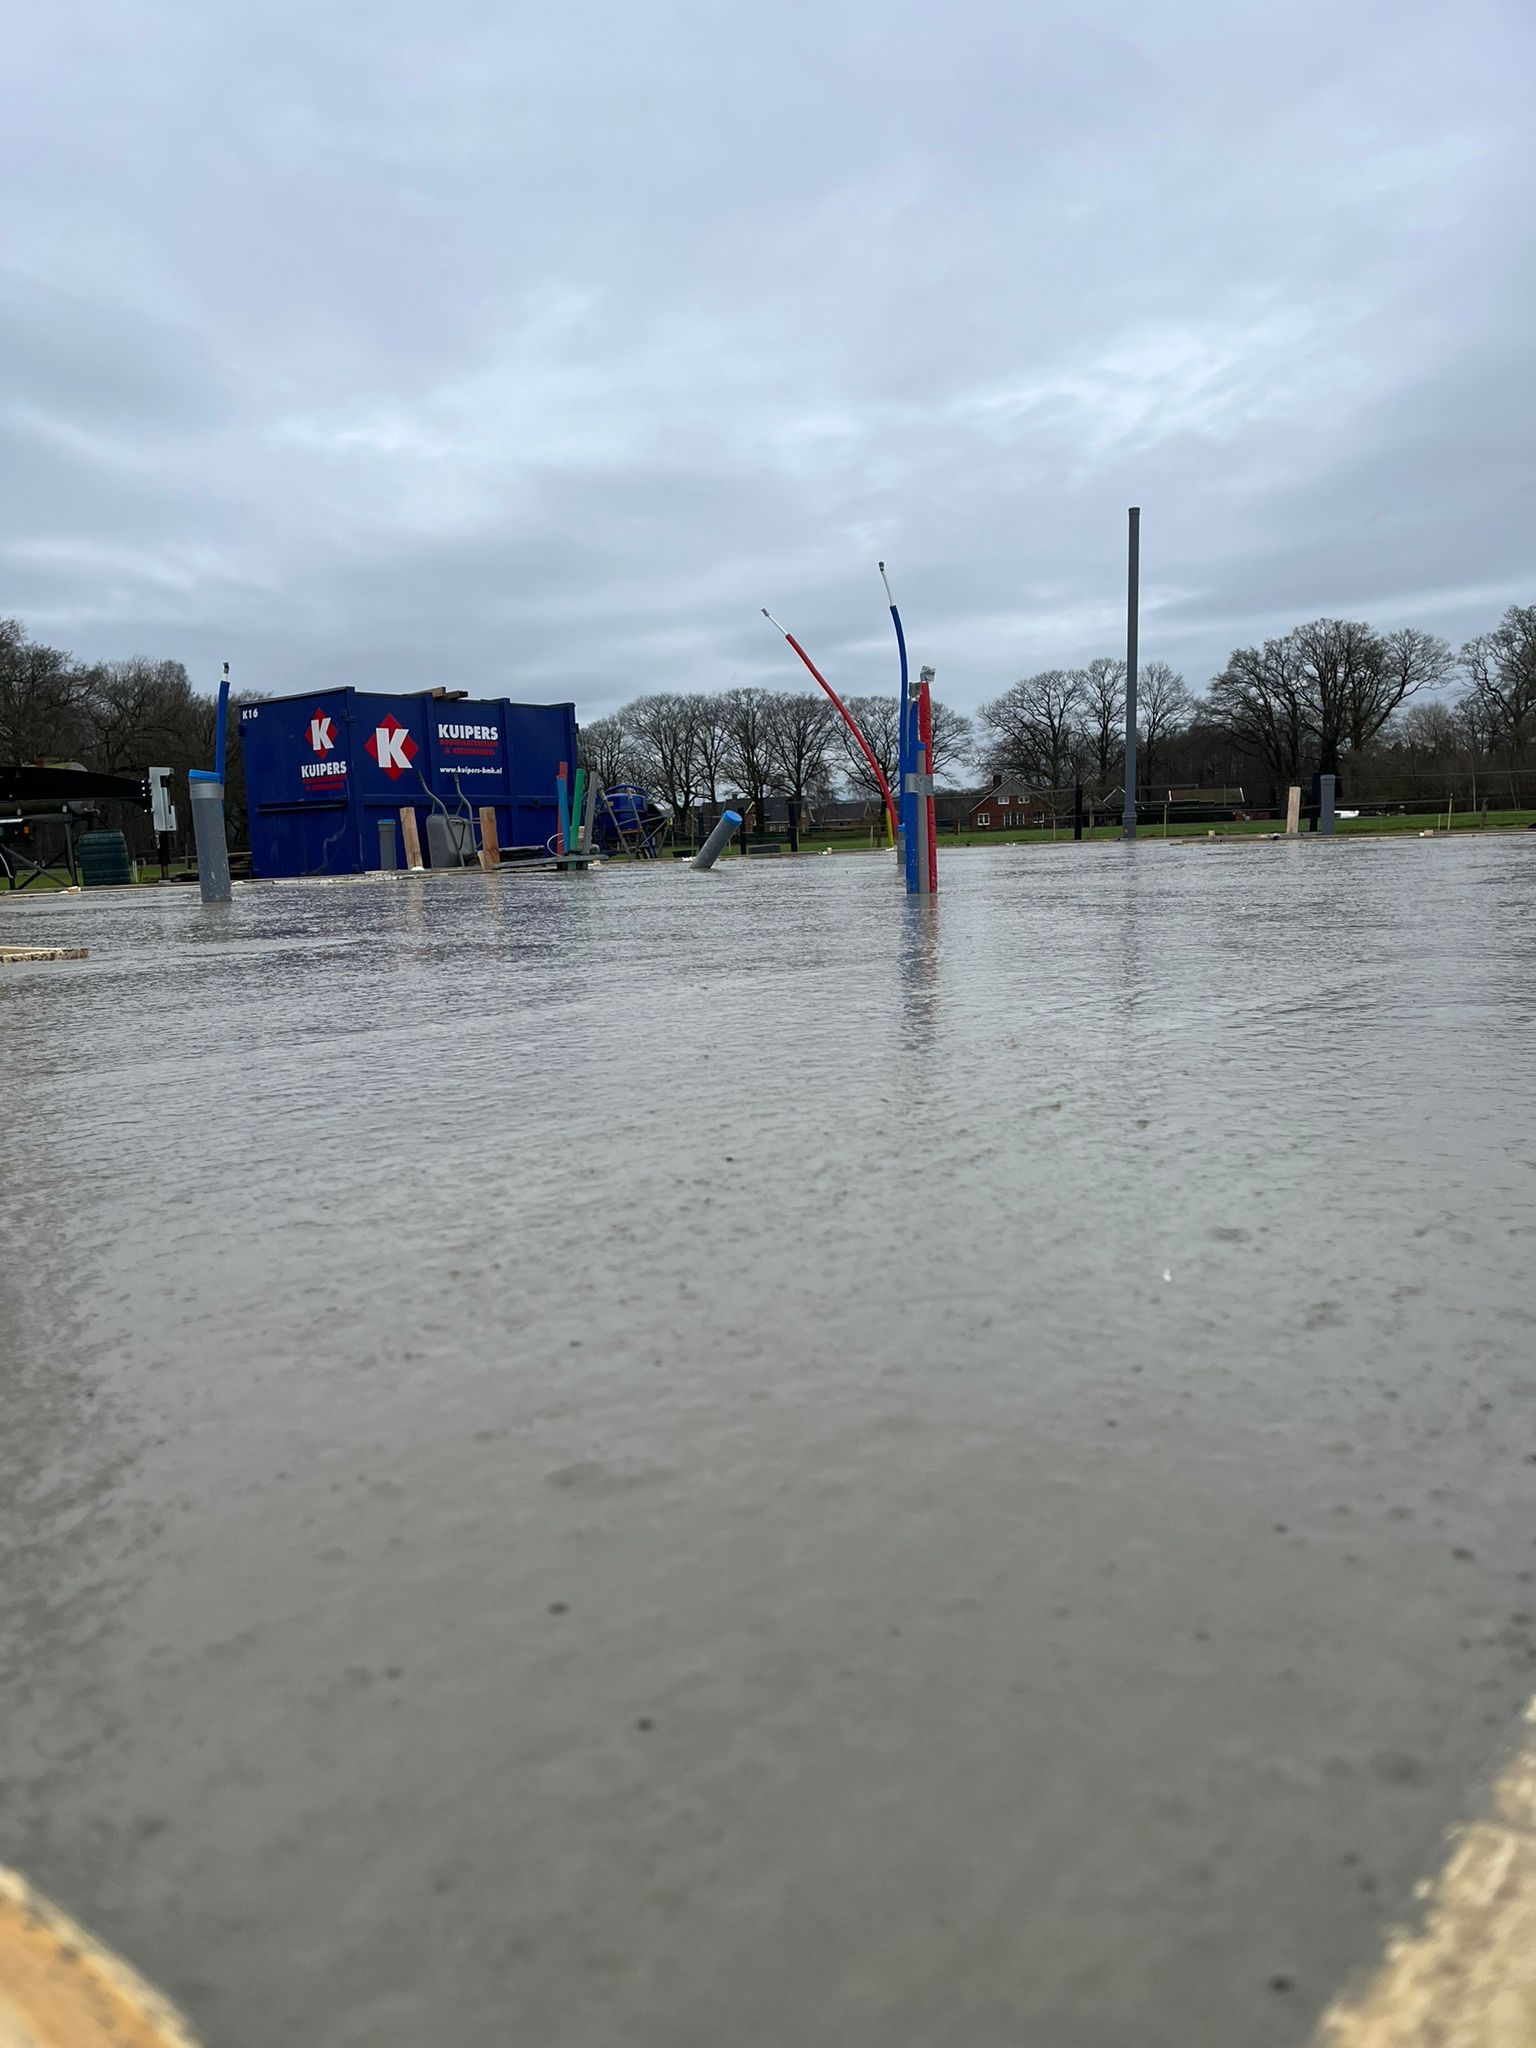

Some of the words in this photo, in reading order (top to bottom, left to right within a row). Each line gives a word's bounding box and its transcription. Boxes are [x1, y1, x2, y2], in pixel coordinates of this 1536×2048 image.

[242, 708, 258, 720] K16
[311, 717, 334, 751] K
[438, 724, 498, 740] KUIPERS
[376, 727, 413, 769] K
[301, 760, 347, 778] KUIPERS
